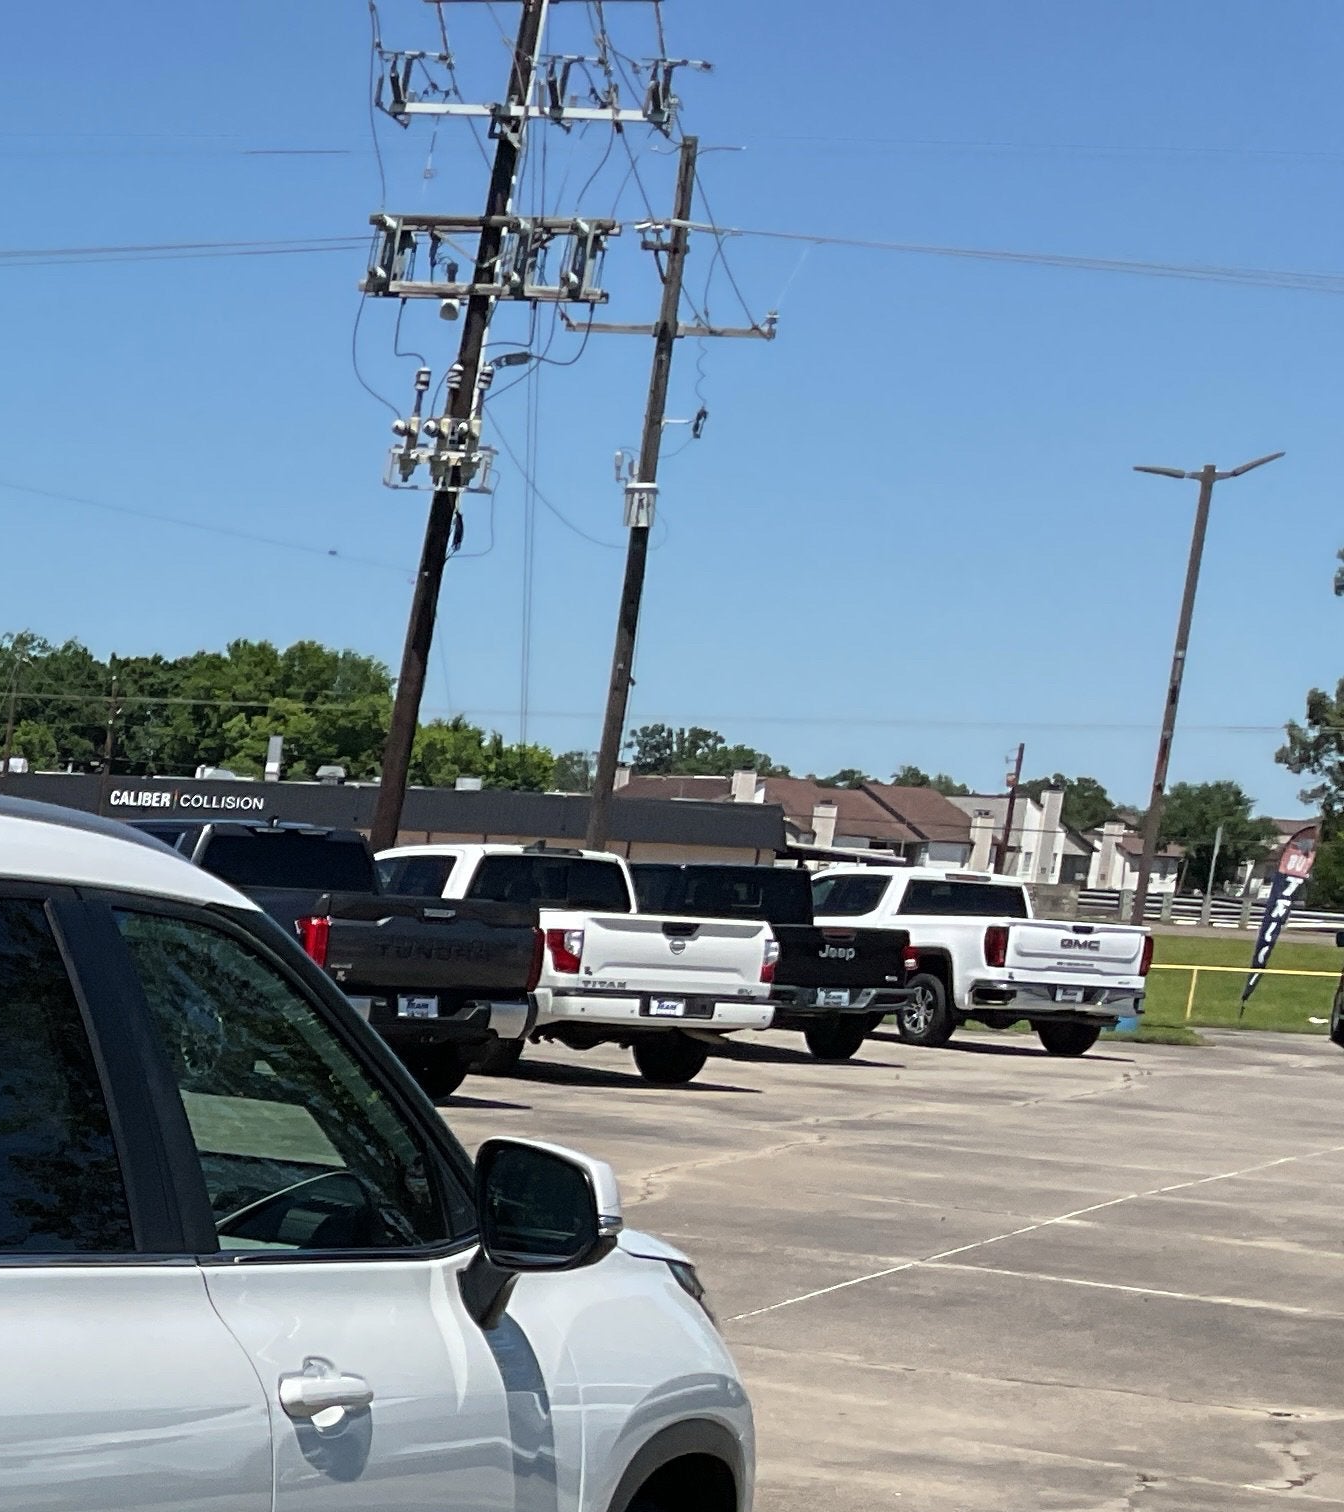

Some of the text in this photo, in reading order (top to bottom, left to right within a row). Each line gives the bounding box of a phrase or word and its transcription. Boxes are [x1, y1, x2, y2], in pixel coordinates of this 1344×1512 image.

[110, 790, 264, 810] CALIBER COLLISION
[1060, 938, 1100, 951] GMC
[819, 944, 856, 961] Jeep
[582, 979, 627, 990] TITAN
